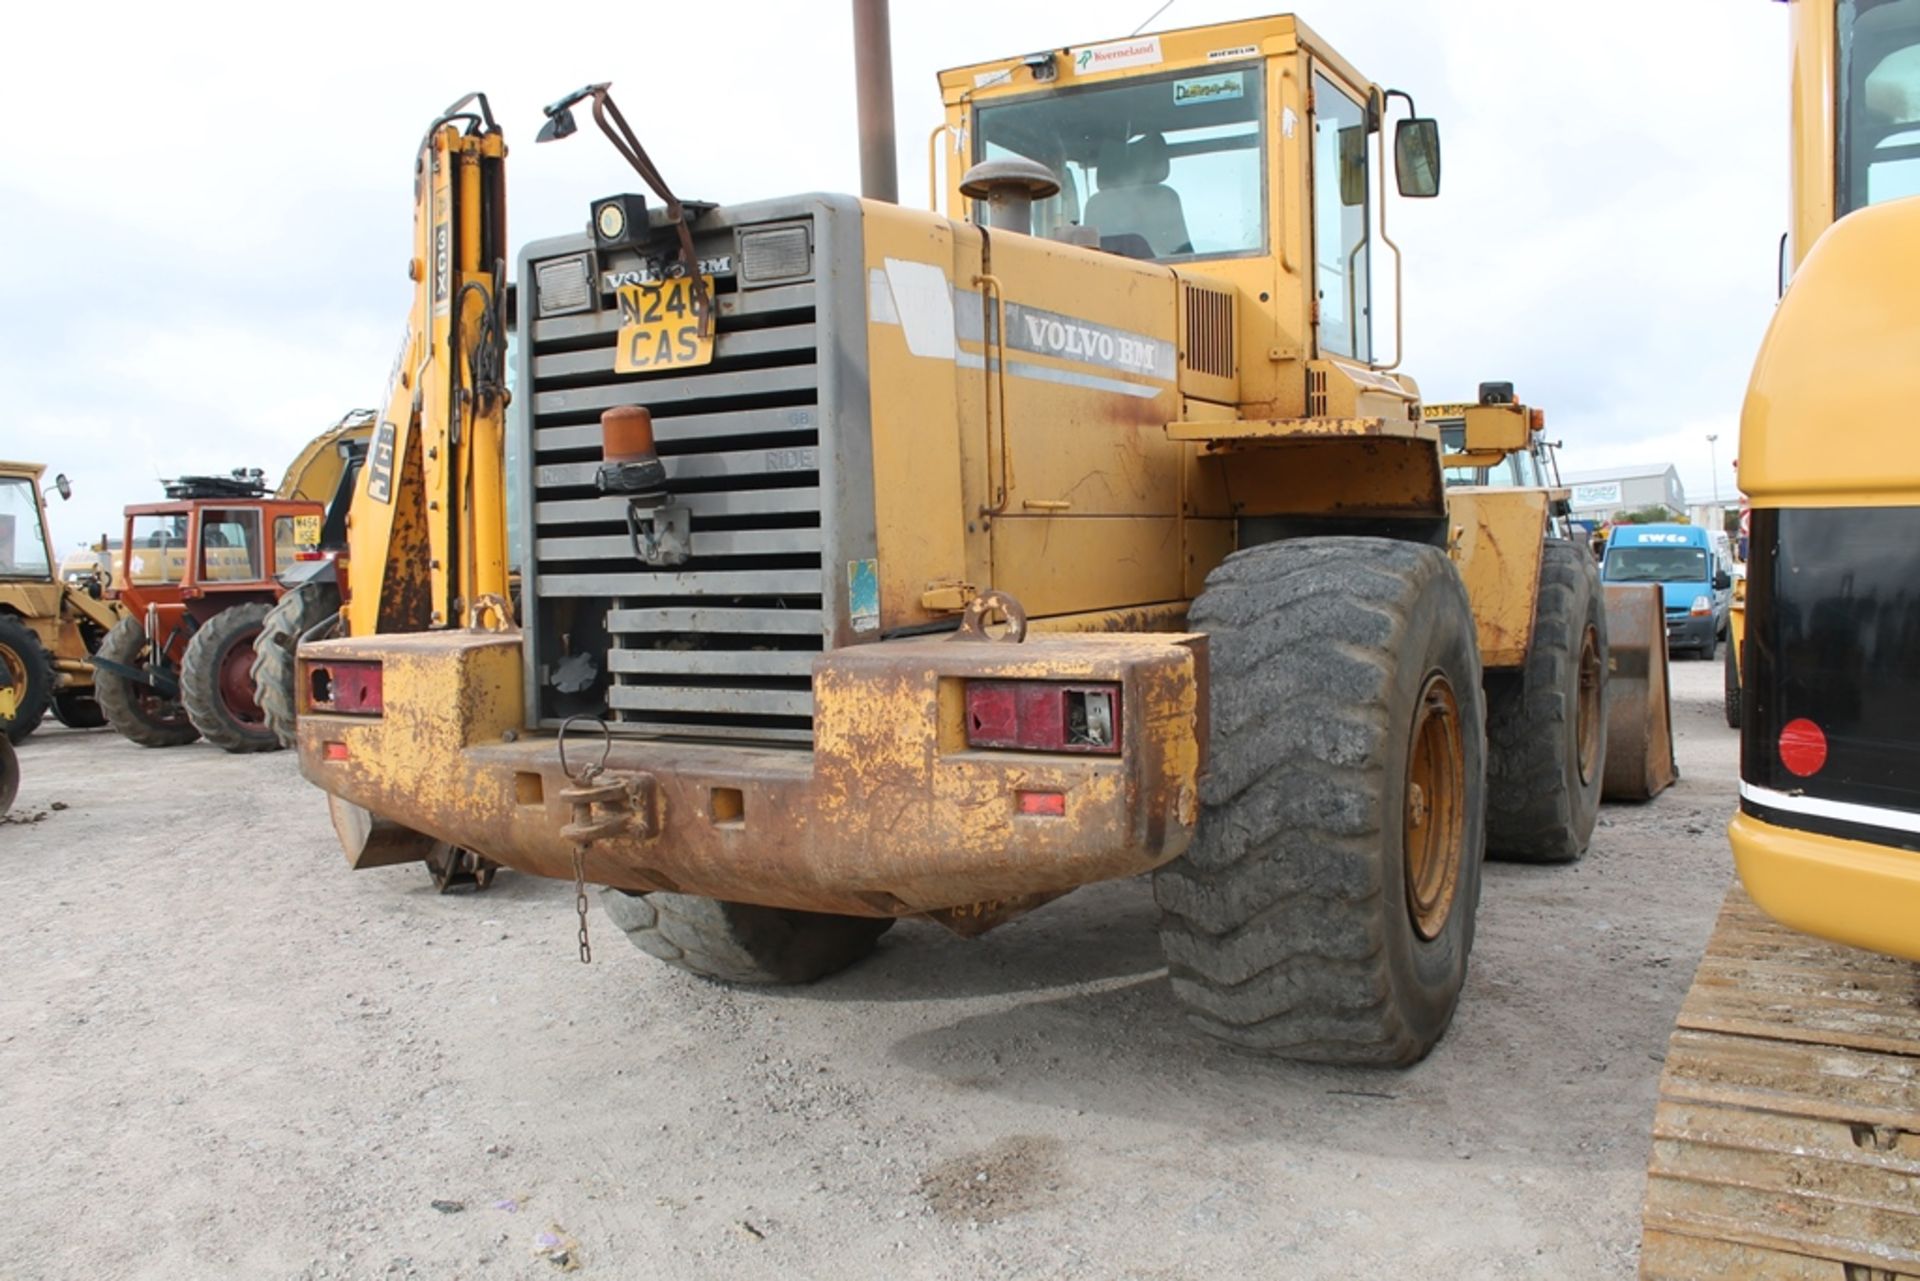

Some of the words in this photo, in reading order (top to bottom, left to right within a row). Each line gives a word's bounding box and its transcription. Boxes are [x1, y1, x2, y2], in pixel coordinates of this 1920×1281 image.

[1093, 45, 1154, 61] Kverneland
[437, 229, 448, 296] 3CX
[630, 327, 698, 366] CAS
[1024, 314, 1114, 360] VOLVO
[1118, 338, 1154, 369] BM
[368, 424, 395, 501] JCB
